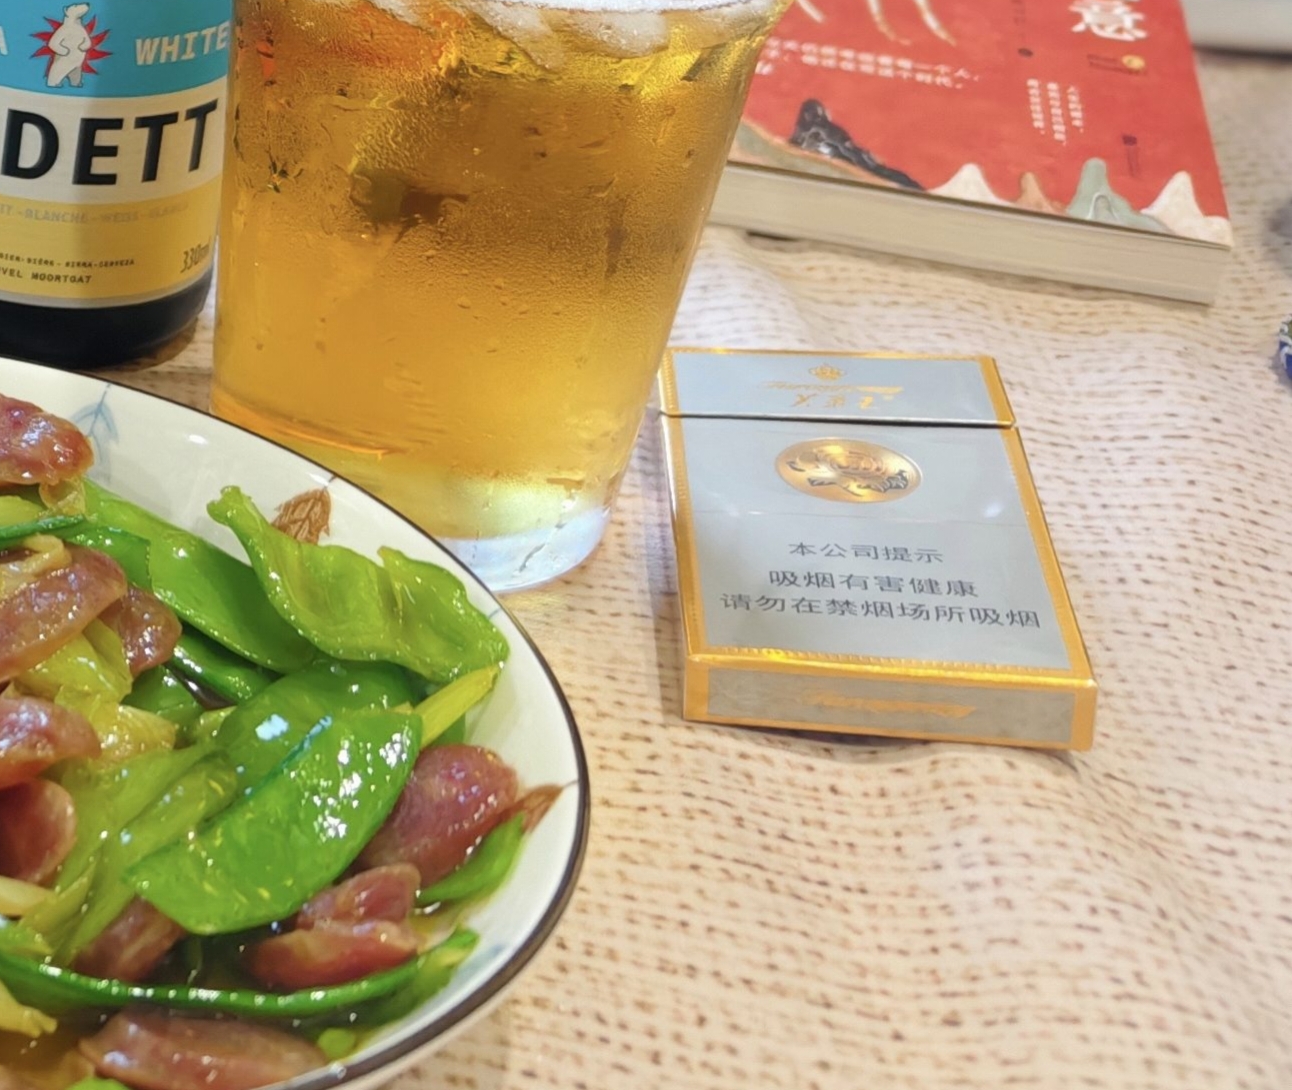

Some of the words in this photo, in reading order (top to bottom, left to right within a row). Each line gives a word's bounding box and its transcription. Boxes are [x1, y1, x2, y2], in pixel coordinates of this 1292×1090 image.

[135, 20, 230, 66] WHITE
[30, 272, 92, 284] MOORTGAT
[788, 541, 944, 564] 本公司提示
[769, 569, 980, 598] 吸烟有害健康
[719, 592, 1041, 629] 请勿在禁烟场所吸烟
